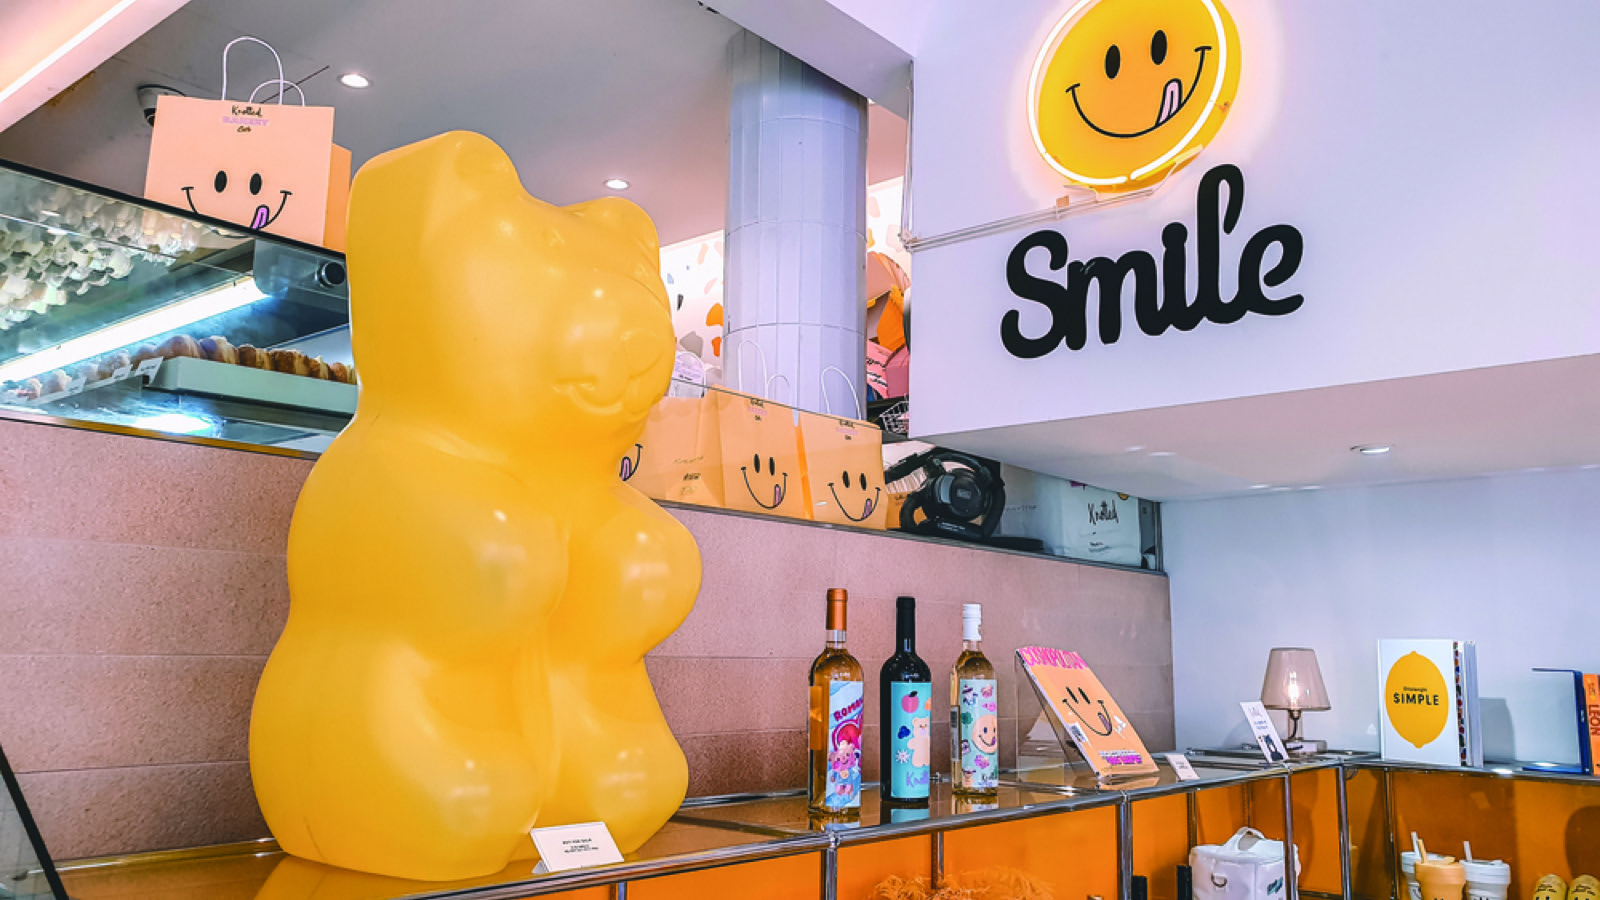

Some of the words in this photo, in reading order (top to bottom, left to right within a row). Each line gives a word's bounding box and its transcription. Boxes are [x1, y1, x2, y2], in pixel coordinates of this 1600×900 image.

[1000, 163, 1304, 359] Smile
[1393, 692, 1440, 706] SIMPLE
[1588, 704, 1600, 737] LEON
